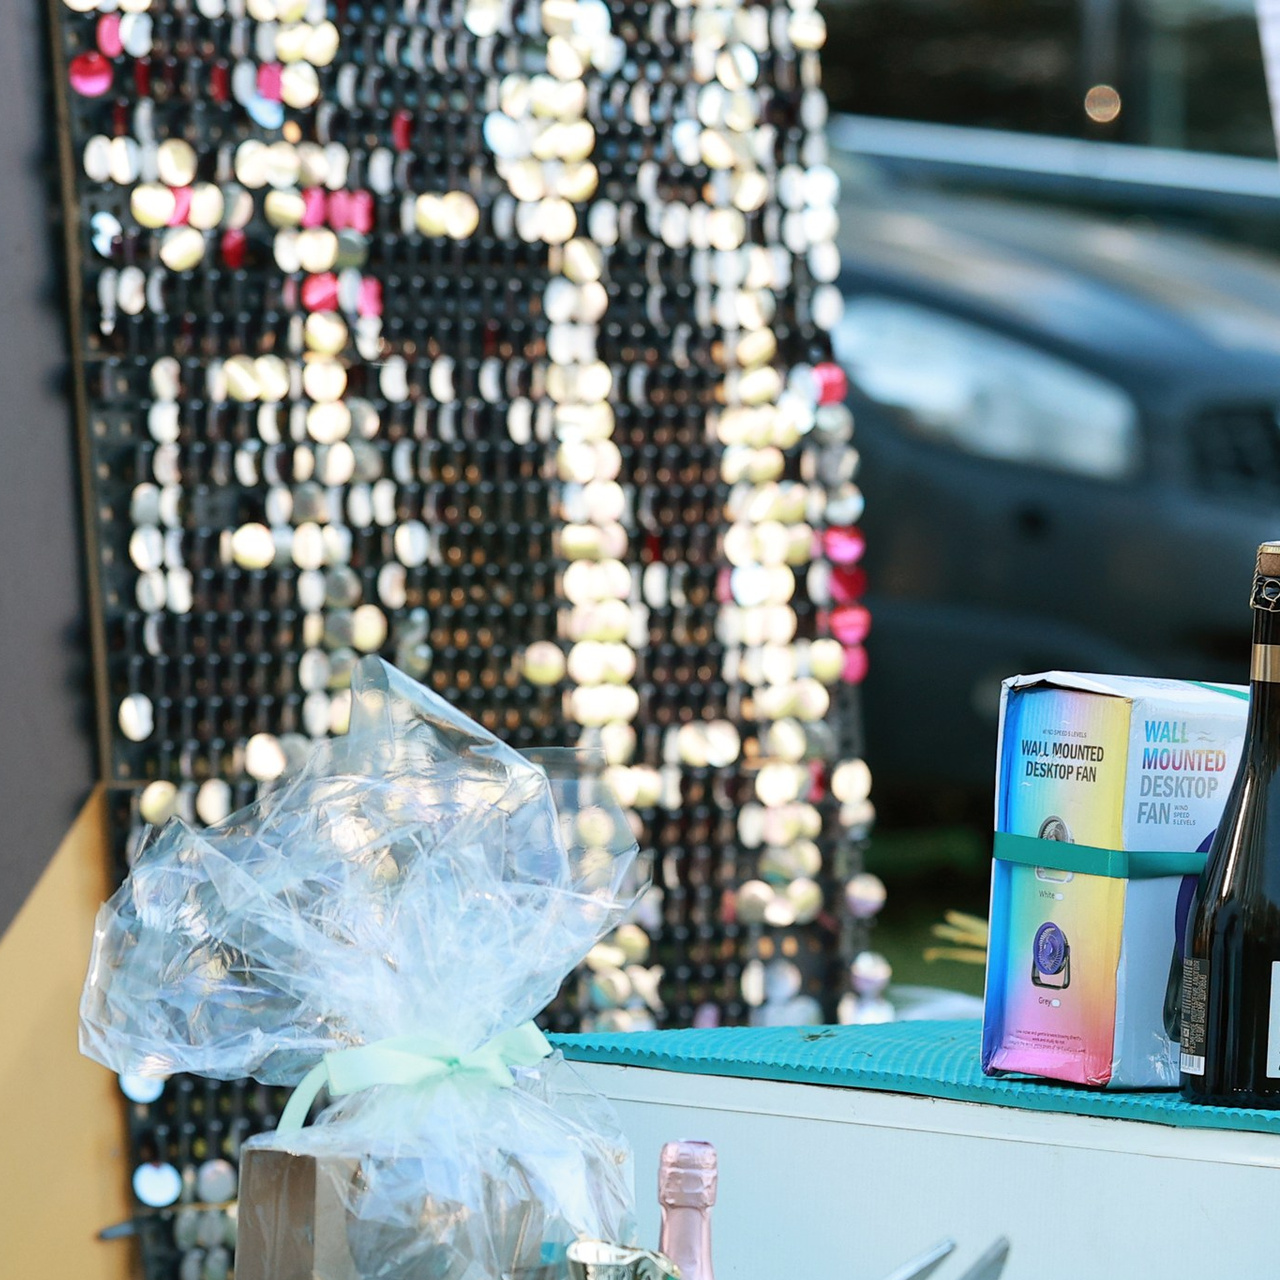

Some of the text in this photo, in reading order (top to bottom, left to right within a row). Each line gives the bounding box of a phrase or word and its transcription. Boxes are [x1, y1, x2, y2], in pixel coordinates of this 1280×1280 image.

[1144, 720, 1189, 743] WALL
[1021, 739, 1104, 762] WALL MOUNTED
[1142, 747, 1226, 772] MOUNTED
[1025, 760, 1097, 783] DESKTOP FAN
[1140, 775, 1219, 799] DESKTOP
[1137, 802, 1171, 825] FAN
[1038, 890, 1056, 900] White
[1038, 996, 1052, 1008] Grey
